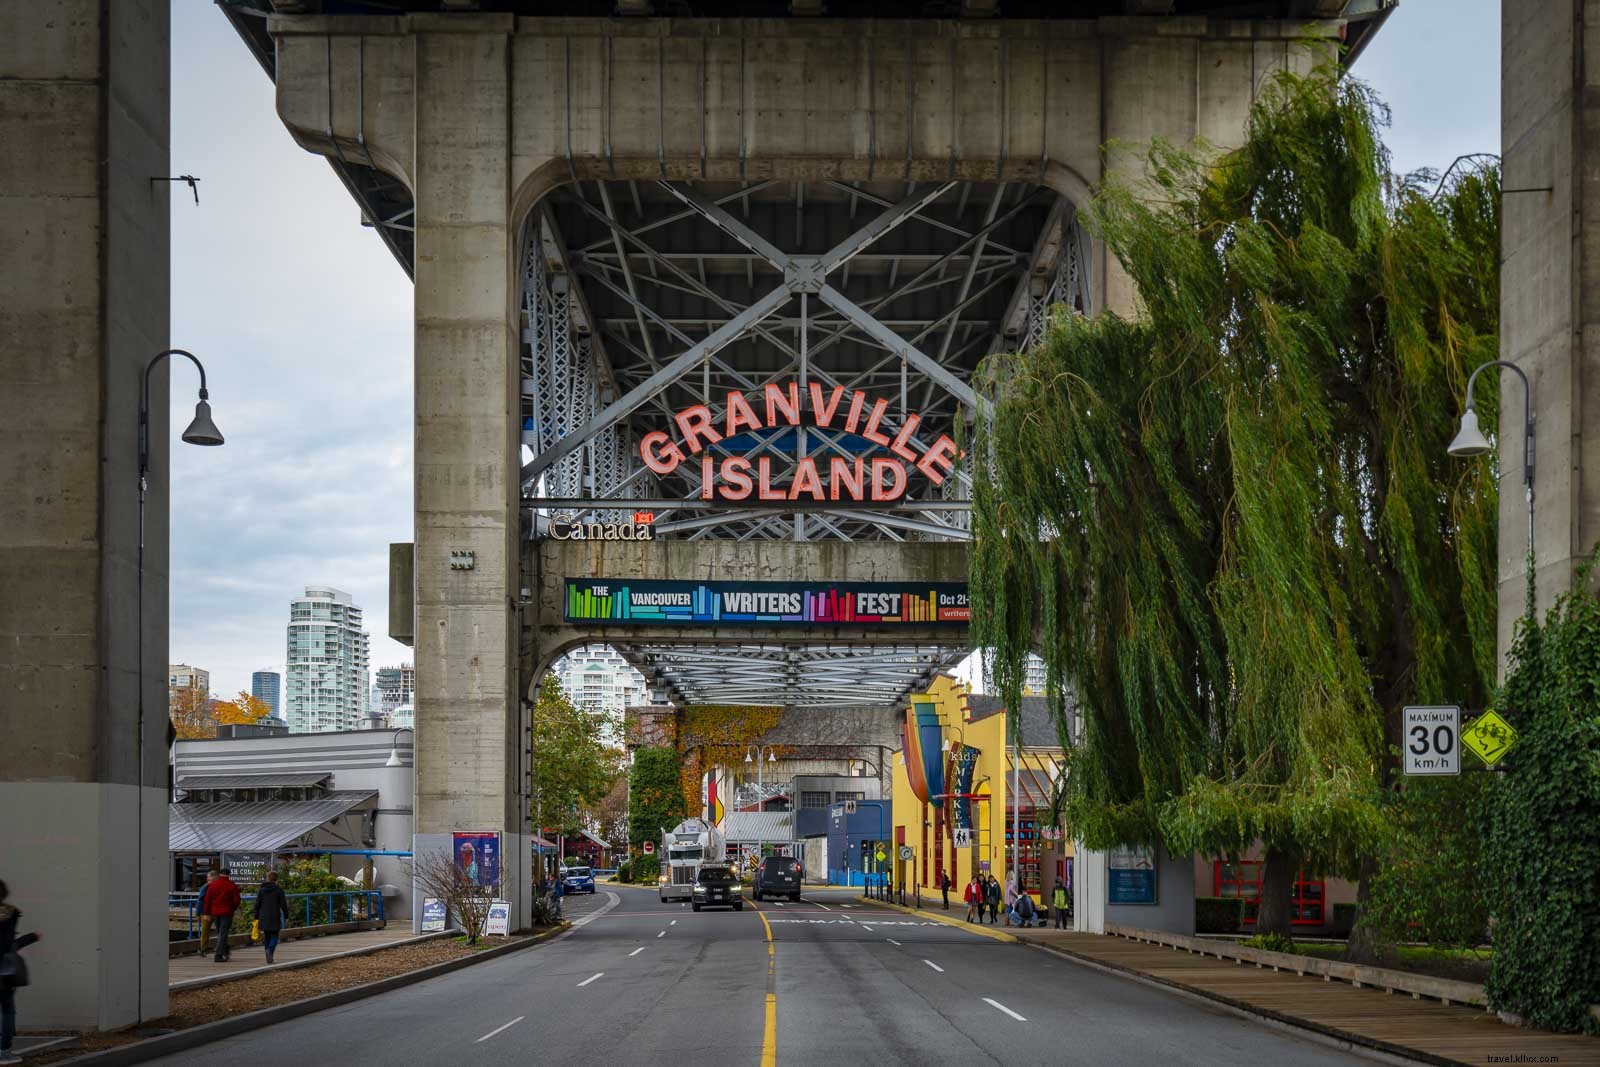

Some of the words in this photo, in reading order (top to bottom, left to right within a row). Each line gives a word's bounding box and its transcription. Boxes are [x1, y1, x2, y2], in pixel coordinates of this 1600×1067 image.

[640, 382, 965, 486] GRANVILLE
[702, 456, 908, 501] ISLAND
[549, 514, 652, 540] Canada
[592, 586, 609, 596] THE
[631, 593, 691, 605] VANCOUVER
[723, 592, 801, 614] WRITERS
[857, 593, 901, 614] FEST
[940, 594, 955, 605] Oct
[1409, 713, 1453, 722] MAXIMUM
[1409, 725, 1454, 755] 30
[1414, 758, 1449, 769] km/h
[953, 765, 966, 829] MARKET
